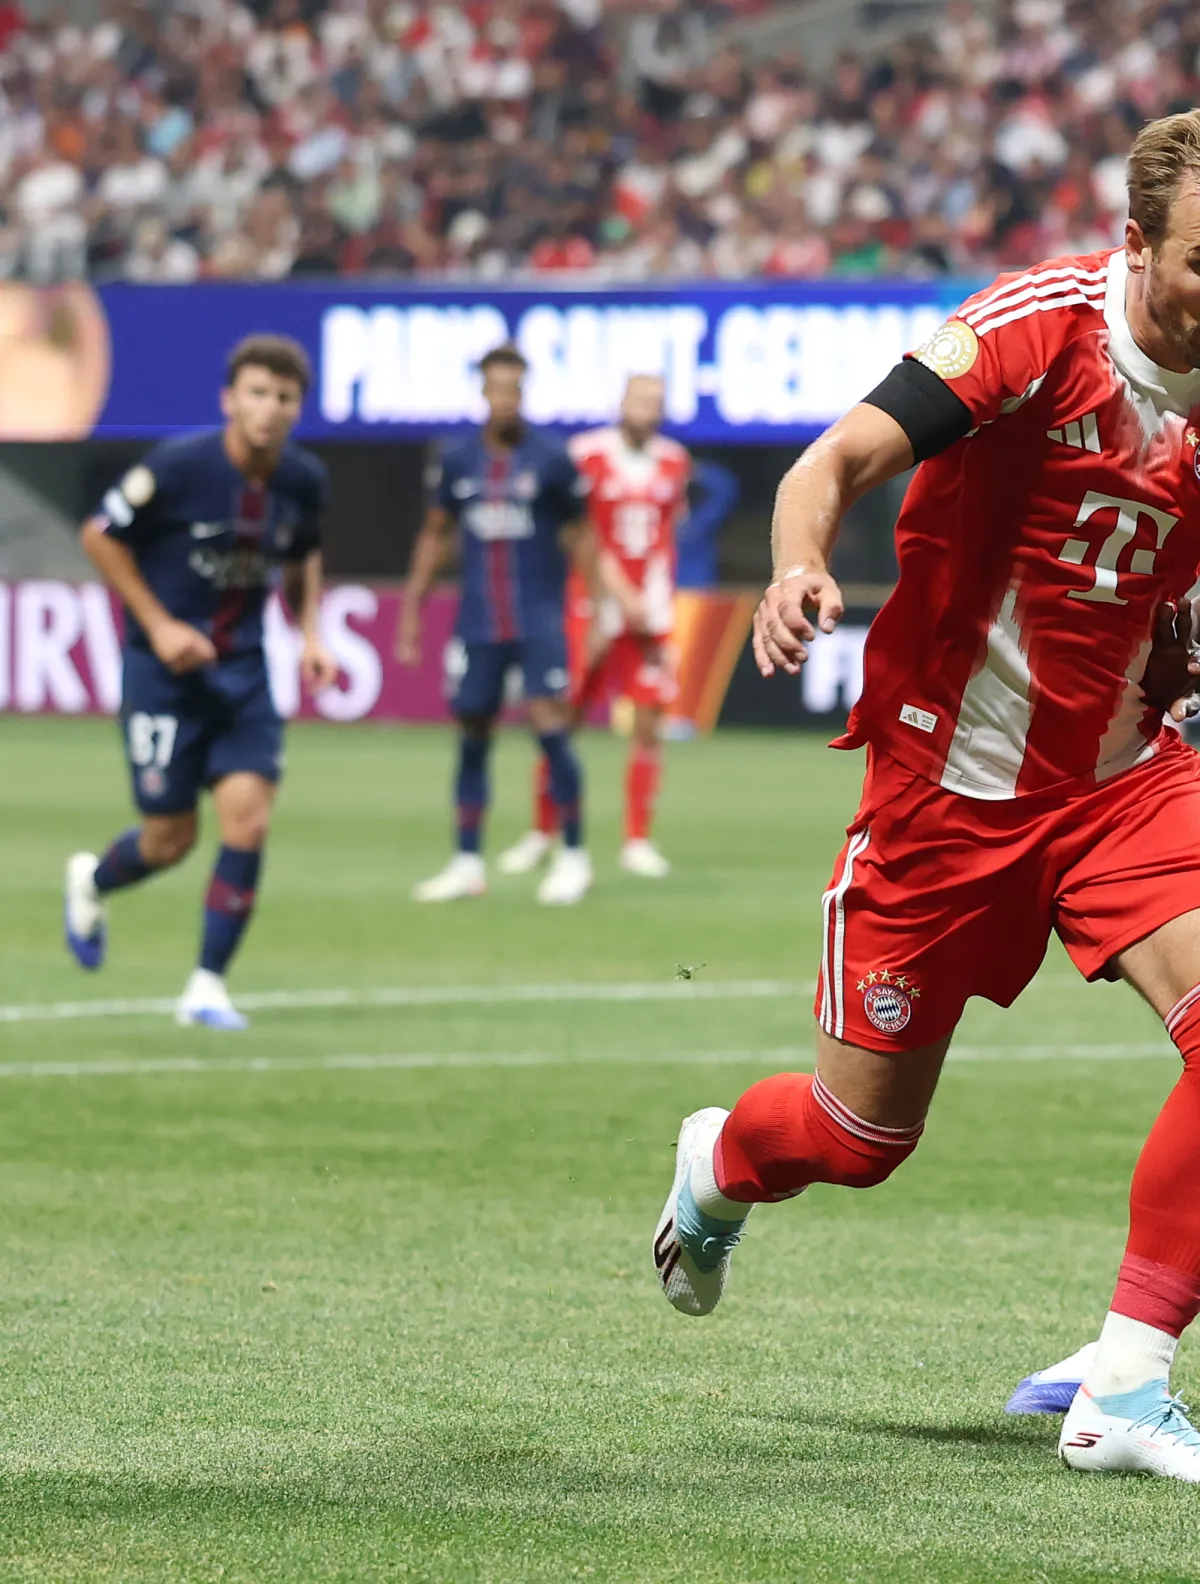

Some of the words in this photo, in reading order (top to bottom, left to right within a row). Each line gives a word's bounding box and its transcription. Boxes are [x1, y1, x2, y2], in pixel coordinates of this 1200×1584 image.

[1058, 490, 1180, 606] T
[867, 992, 876, 1004] FC
[876, 988, 907, 1007] BAYERN
